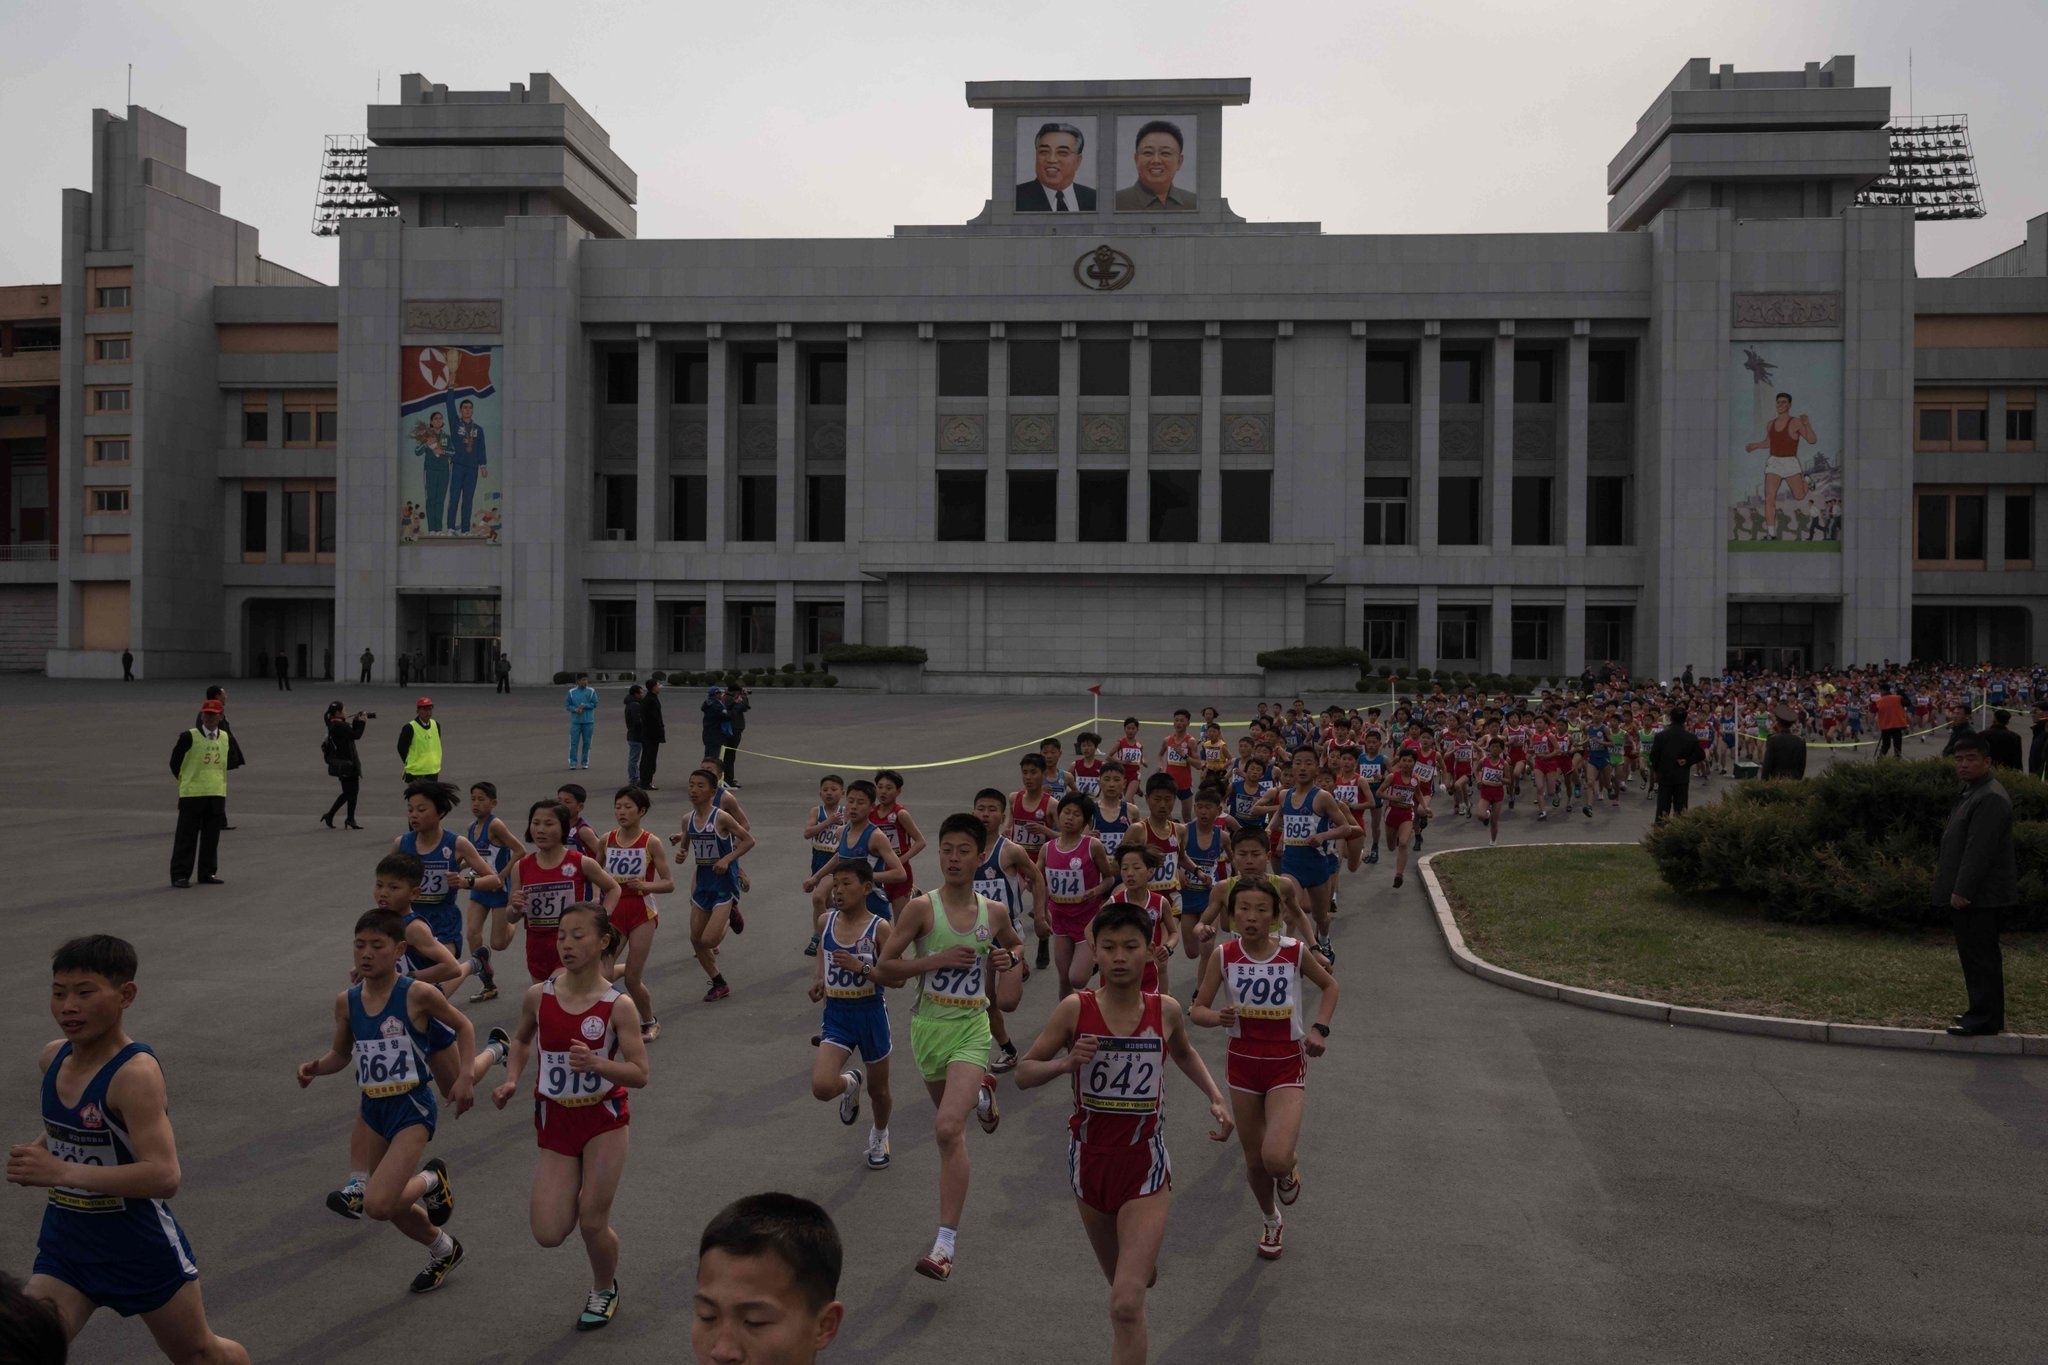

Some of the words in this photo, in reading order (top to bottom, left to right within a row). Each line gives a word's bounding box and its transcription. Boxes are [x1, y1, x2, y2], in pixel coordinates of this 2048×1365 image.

[204, 752, 220, 764] 52
[1286, 823, 1310, 838] 695
[609, 857, 642, 875] 762
[1051, 877, 1079, 895] 914
[531, 896, 566, 916] 851
[931, 968, 981, 996] 573
[1236, 977, 1288, 1005] 798
[360, 1050, 409, 1083] 664
[1090, 1061, 1153, 1095] 642
[548, 1067, 601, 1095] 915
